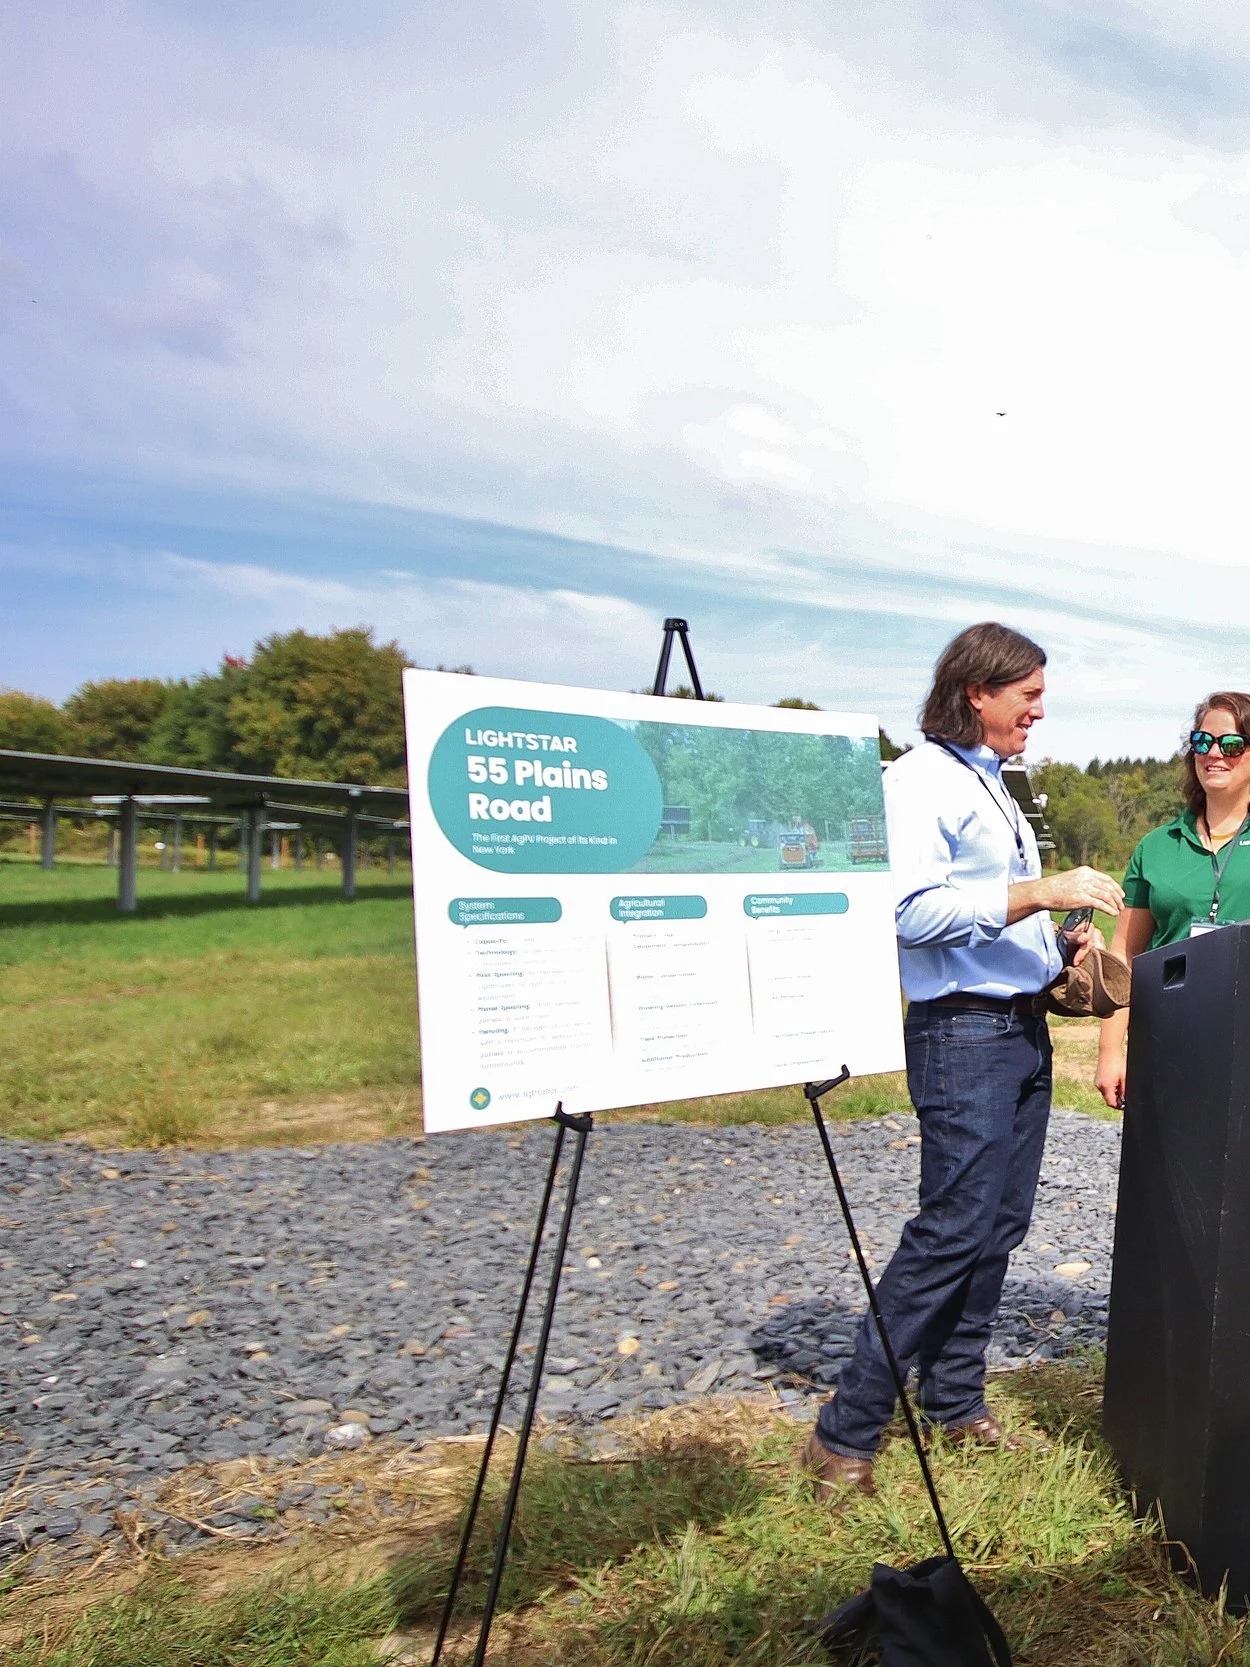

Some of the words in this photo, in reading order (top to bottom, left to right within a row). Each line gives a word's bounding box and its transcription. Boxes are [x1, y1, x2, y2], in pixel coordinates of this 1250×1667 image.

[465, 728, 577, 753] LIGHTSTAR
[467, 755, 508, 785] 55
[514, 759, 608, 791] Plains
[468, 792, 552, 822] Road
[472, 833, 489, 843] The
[535, 835, 566, 847] Project
[472, 845, 492, 855] New
[458, 900, 495, 912] System
[618, 898, 666, 910] Agricultural
[750, 895, 794, 906] Community
[458, 911, 525, 923] Specifications
[619, 909, 664, 920] Integration
